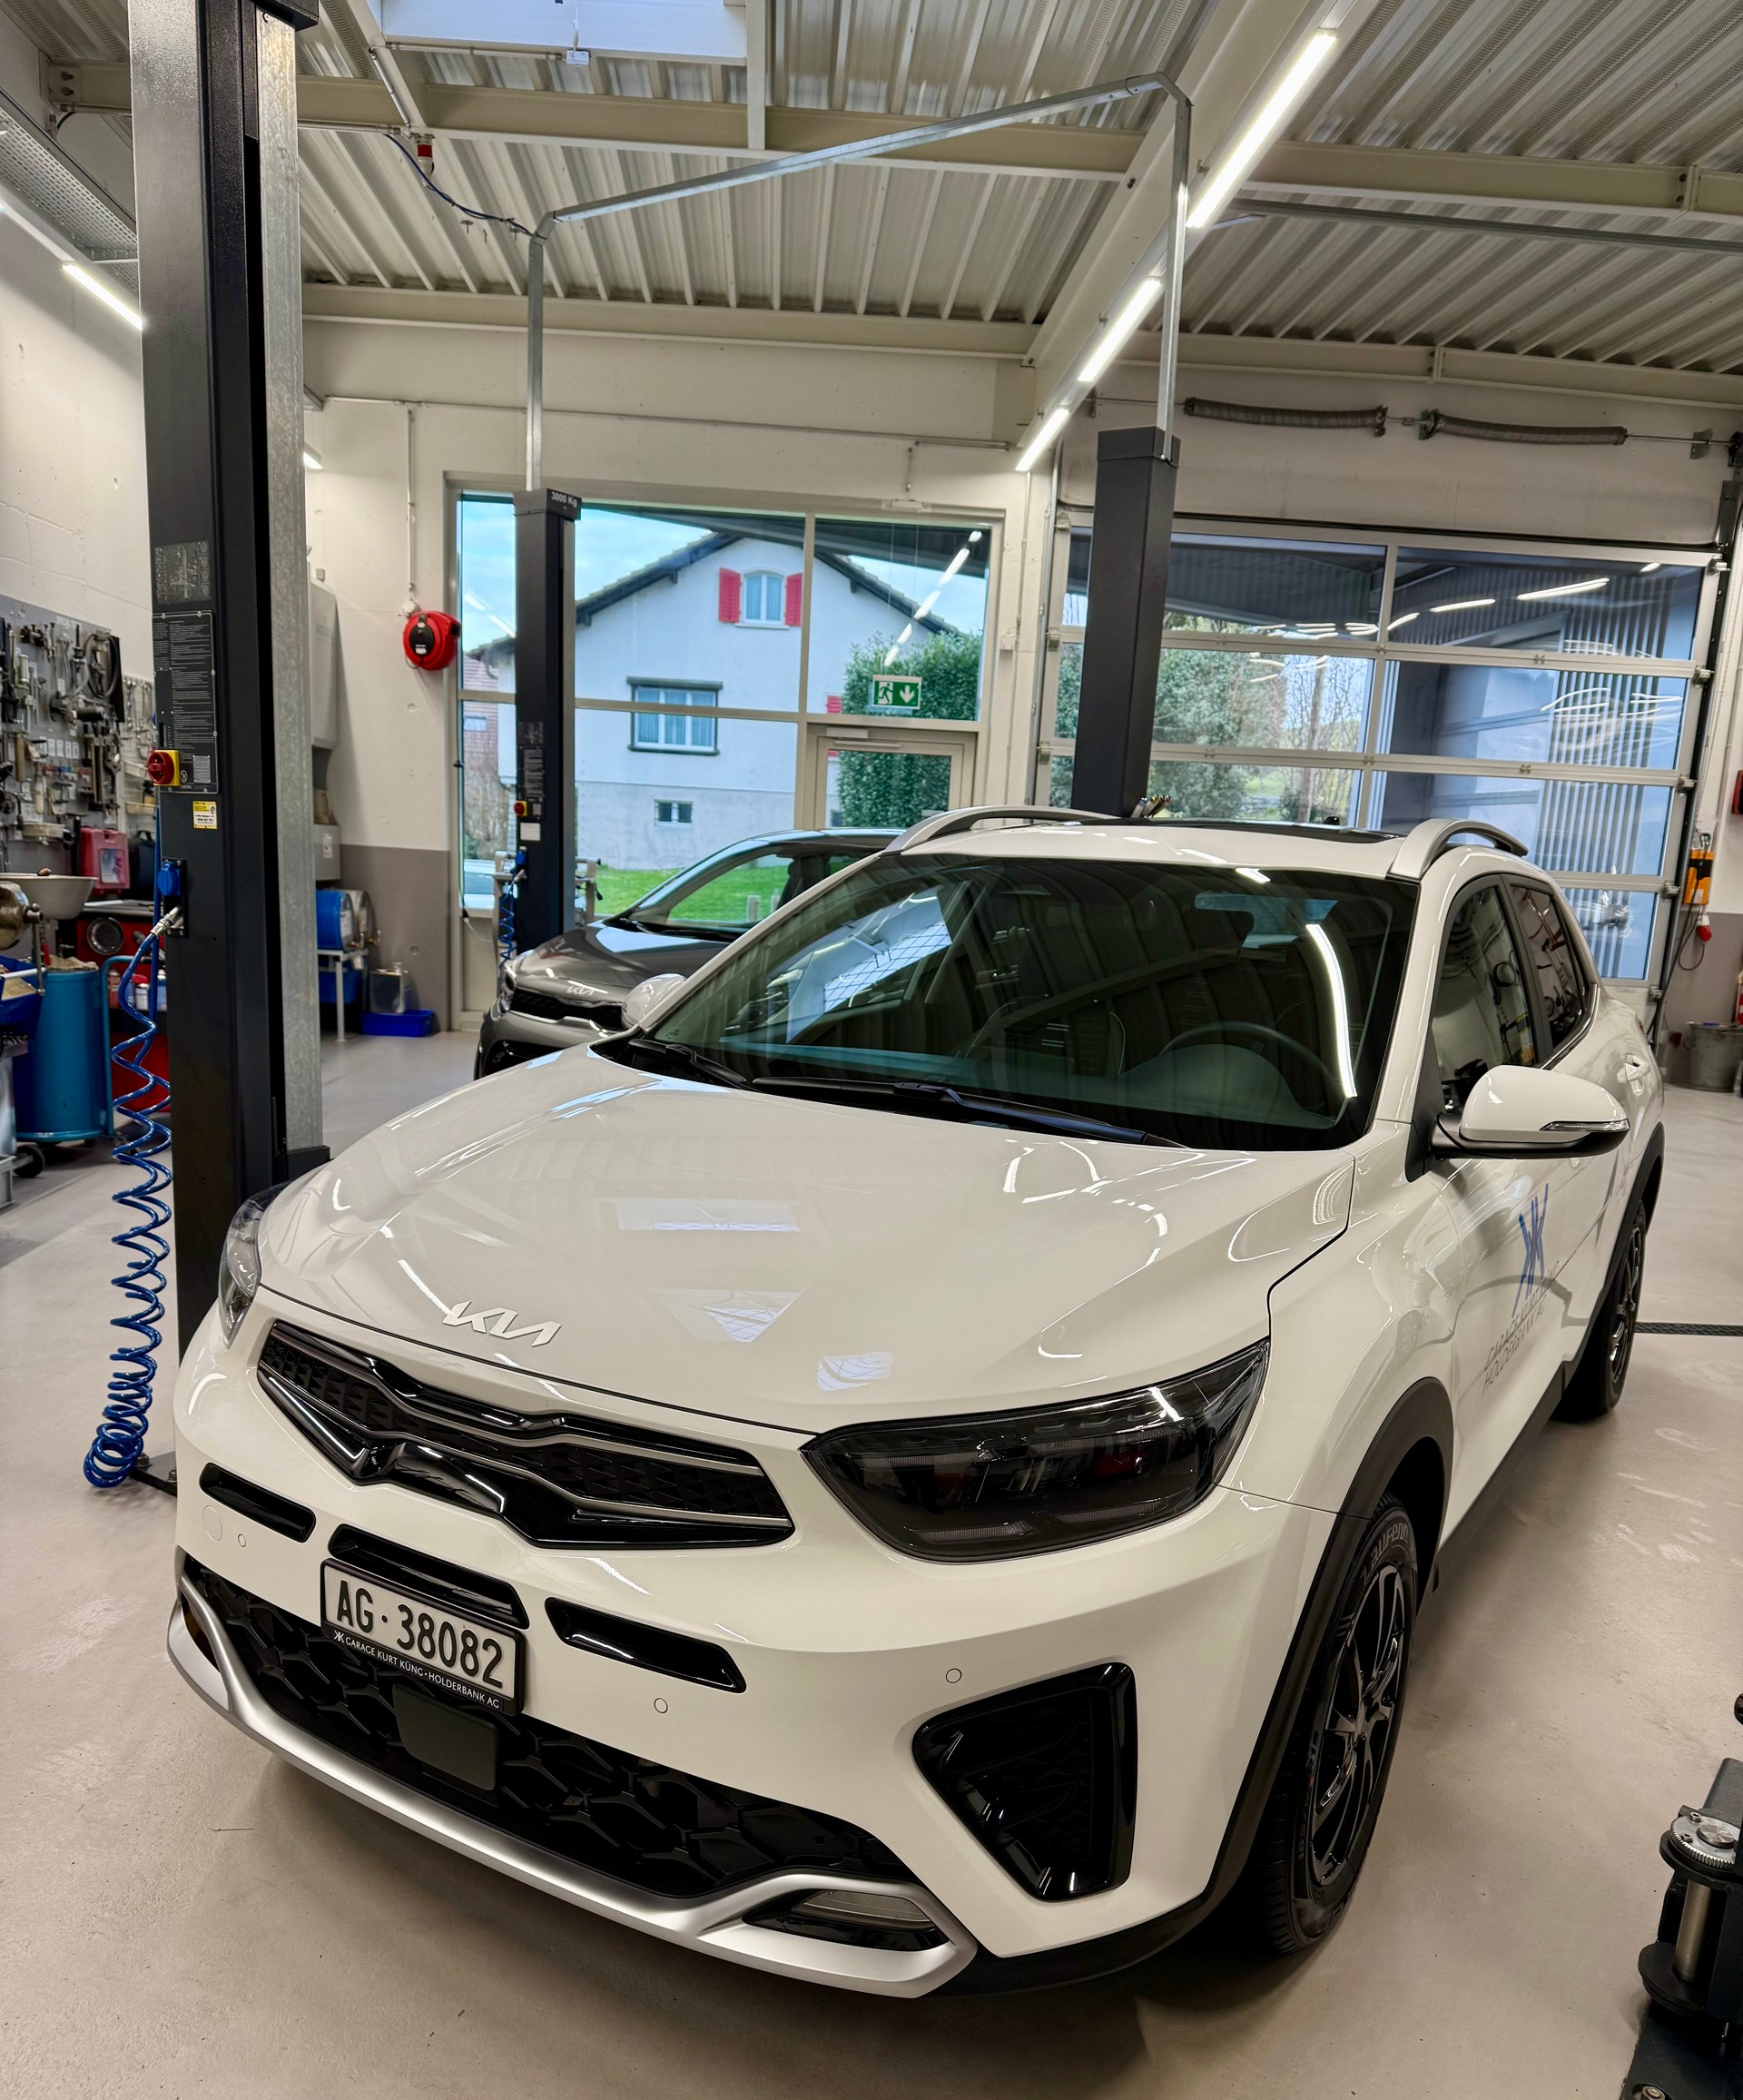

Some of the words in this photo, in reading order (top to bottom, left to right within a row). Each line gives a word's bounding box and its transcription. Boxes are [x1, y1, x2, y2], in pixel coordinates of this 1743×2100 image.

[551, 491, 567, 503] 3000
[566, 985, 595, 996] KIA
[443, 1300, 562, 1347] KIA
[345, 1636, 375, 1656] GARAGE
[377, 1650, 398, 1665] KURT
[428, 1671, 485, 1702] HOLDERBANK
[487, 1697, 499, 1709] AG
